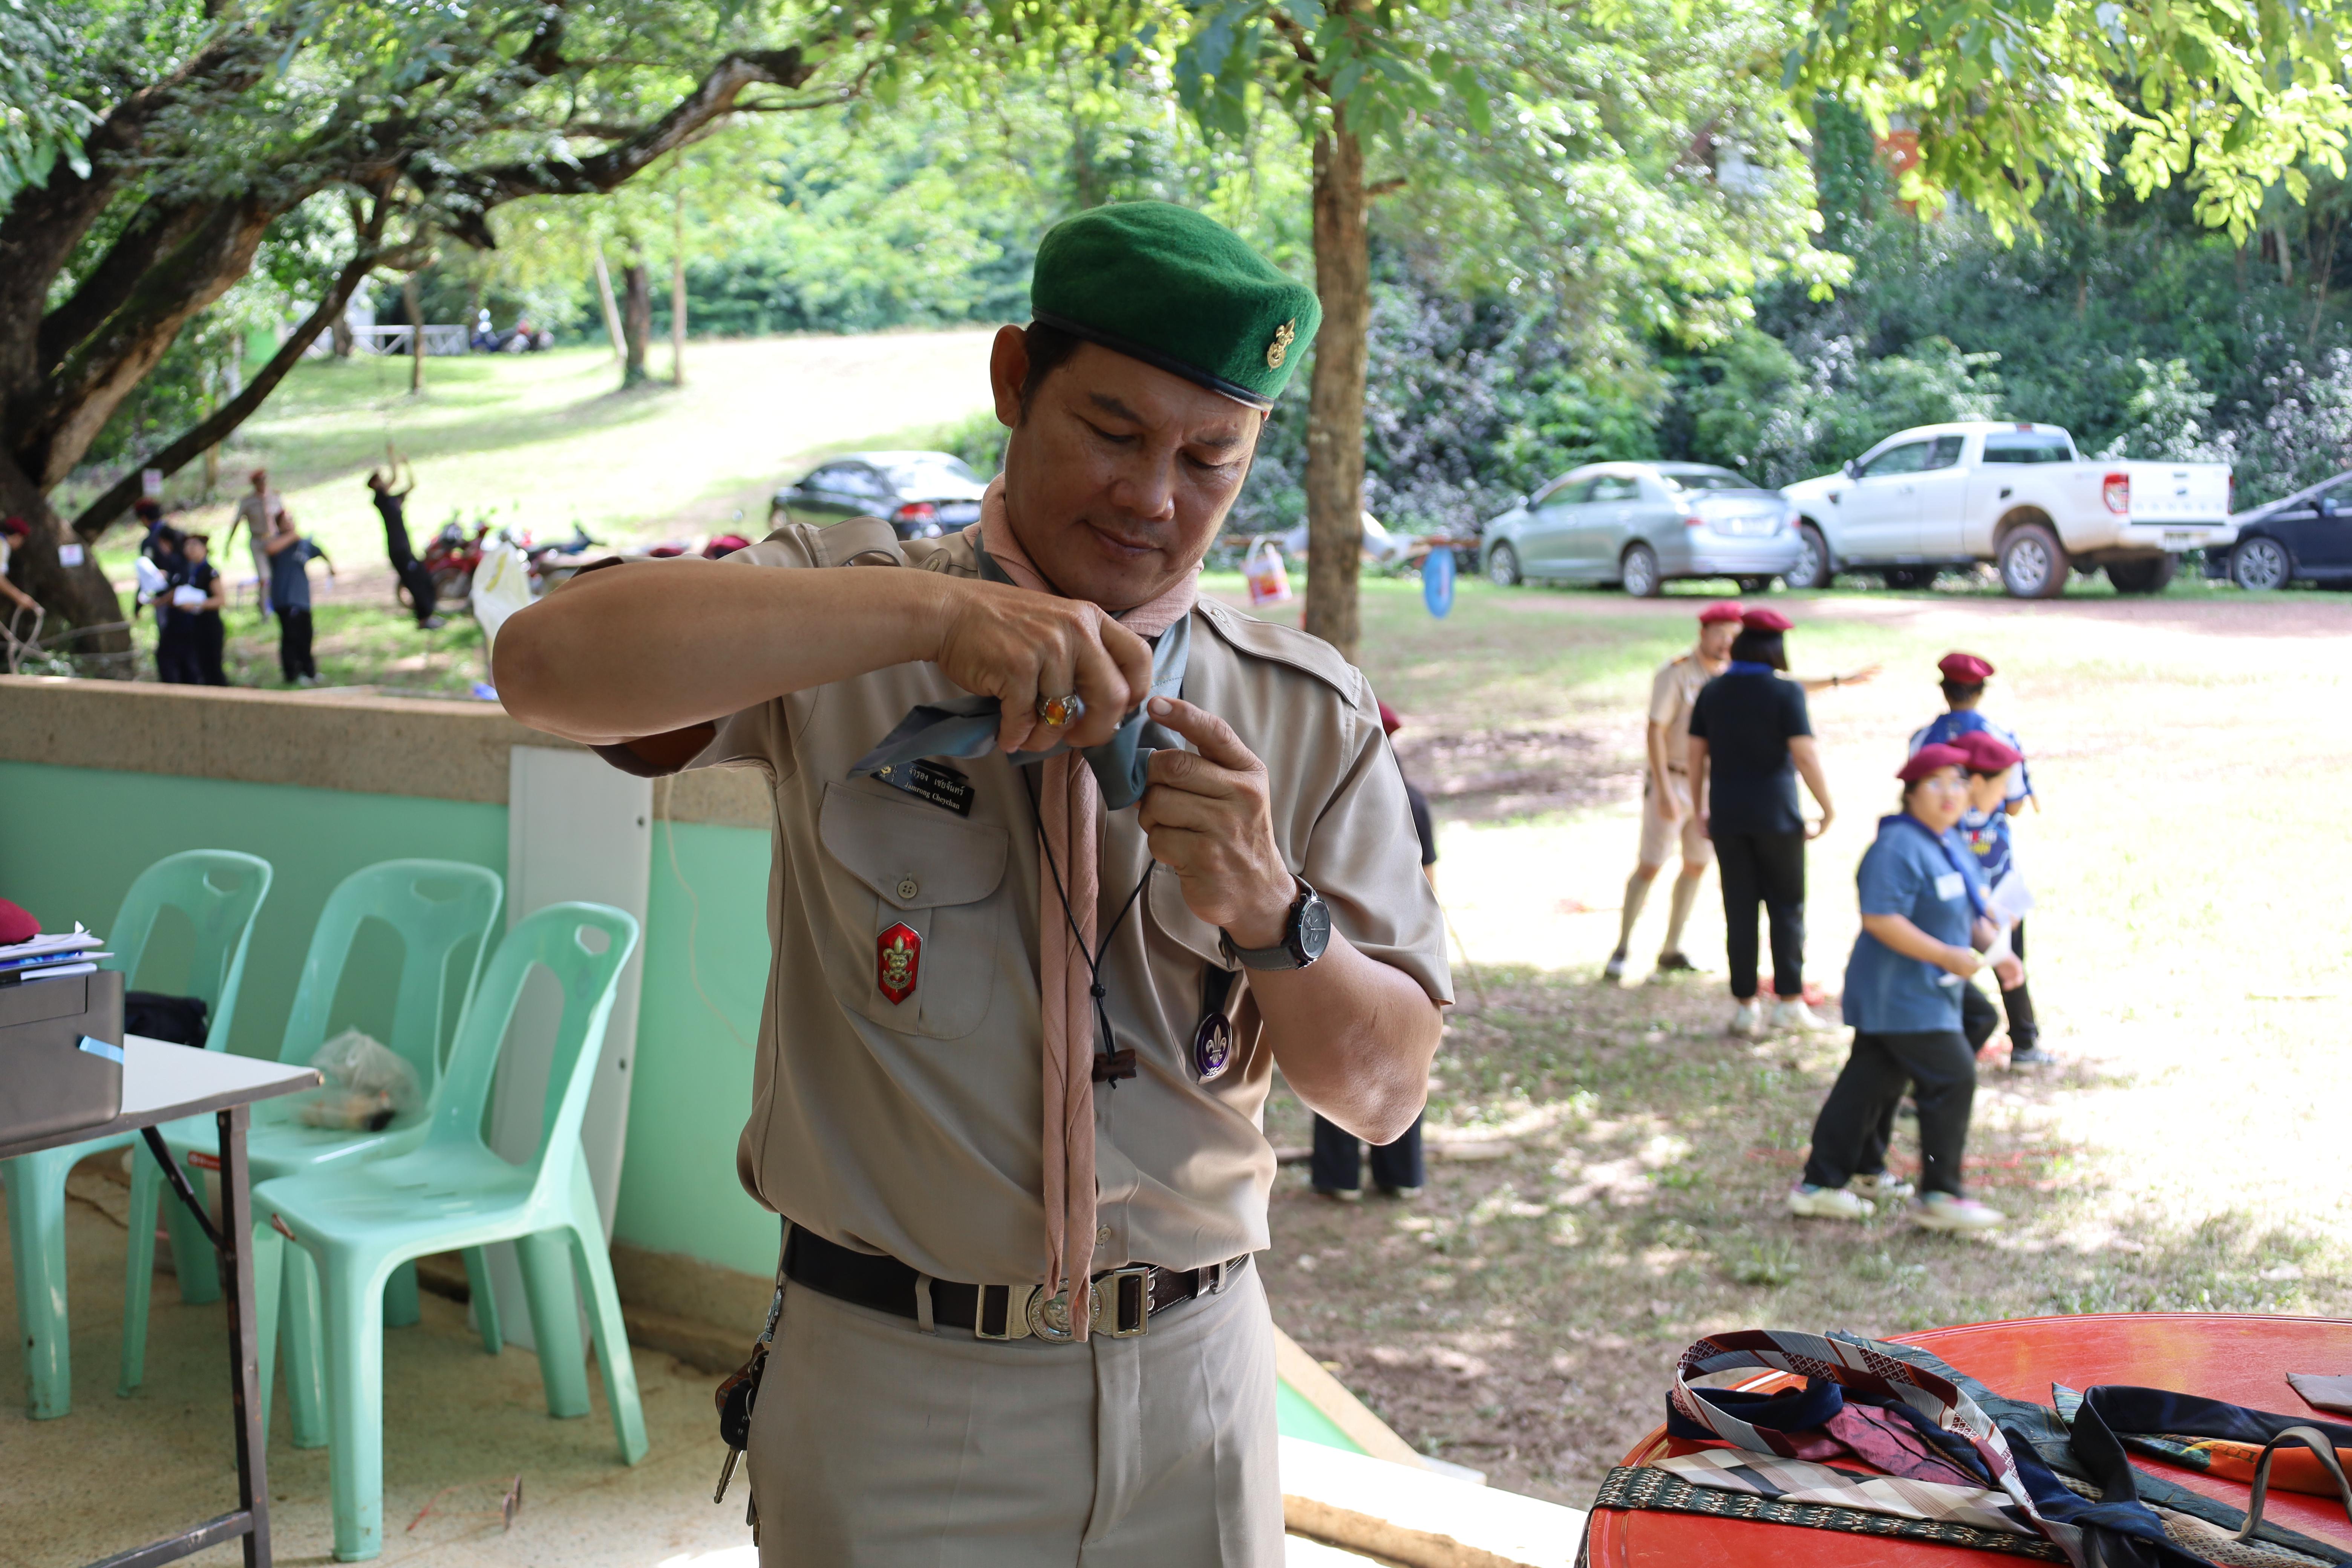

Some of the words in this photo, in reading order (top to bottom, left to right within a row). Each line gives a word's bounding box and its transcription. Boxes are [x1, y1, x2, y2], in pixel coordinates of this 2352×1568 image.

[909, 766, 929, 781] จำรอง
[934, 778, 965, 796] เชยจันทร์
[904, 782, 930, 798] Jamrong
[932, 793, 960, 809] Cheychan
